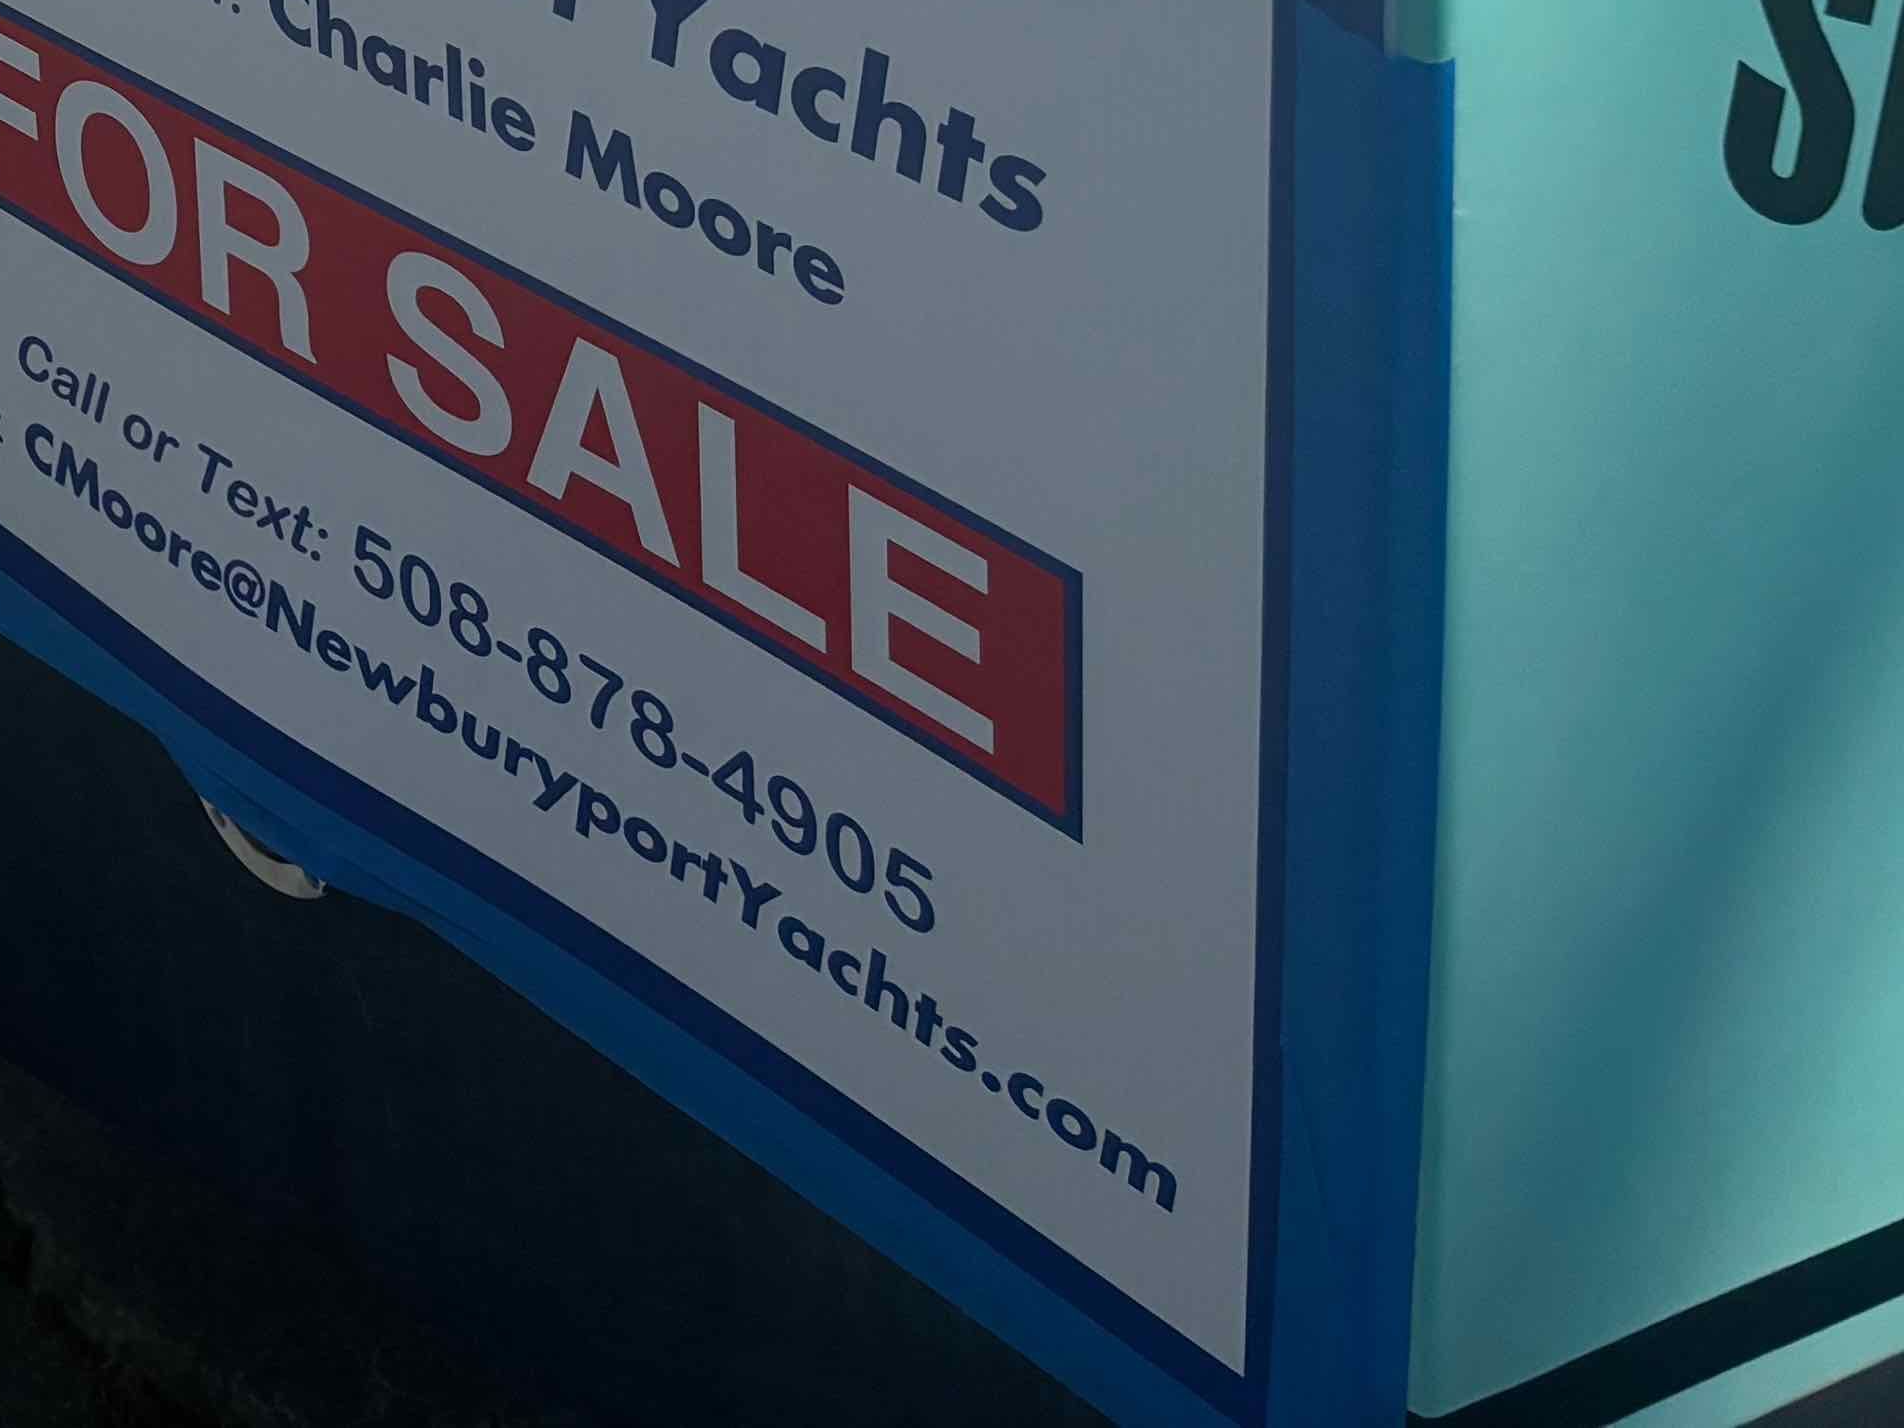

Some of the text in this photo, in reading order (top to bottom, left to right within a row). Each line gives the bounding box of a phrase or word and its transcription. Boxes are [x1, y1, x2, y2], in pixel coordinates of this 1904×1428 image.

[567, 110, 844, 305] Moore
[19, 336, 935, 933] Call or Text: 508-878-4905
[387, 252, 993, 755] SALE
[25, 423, 1178, 1213] CMoore@NewburyportYachts.com
